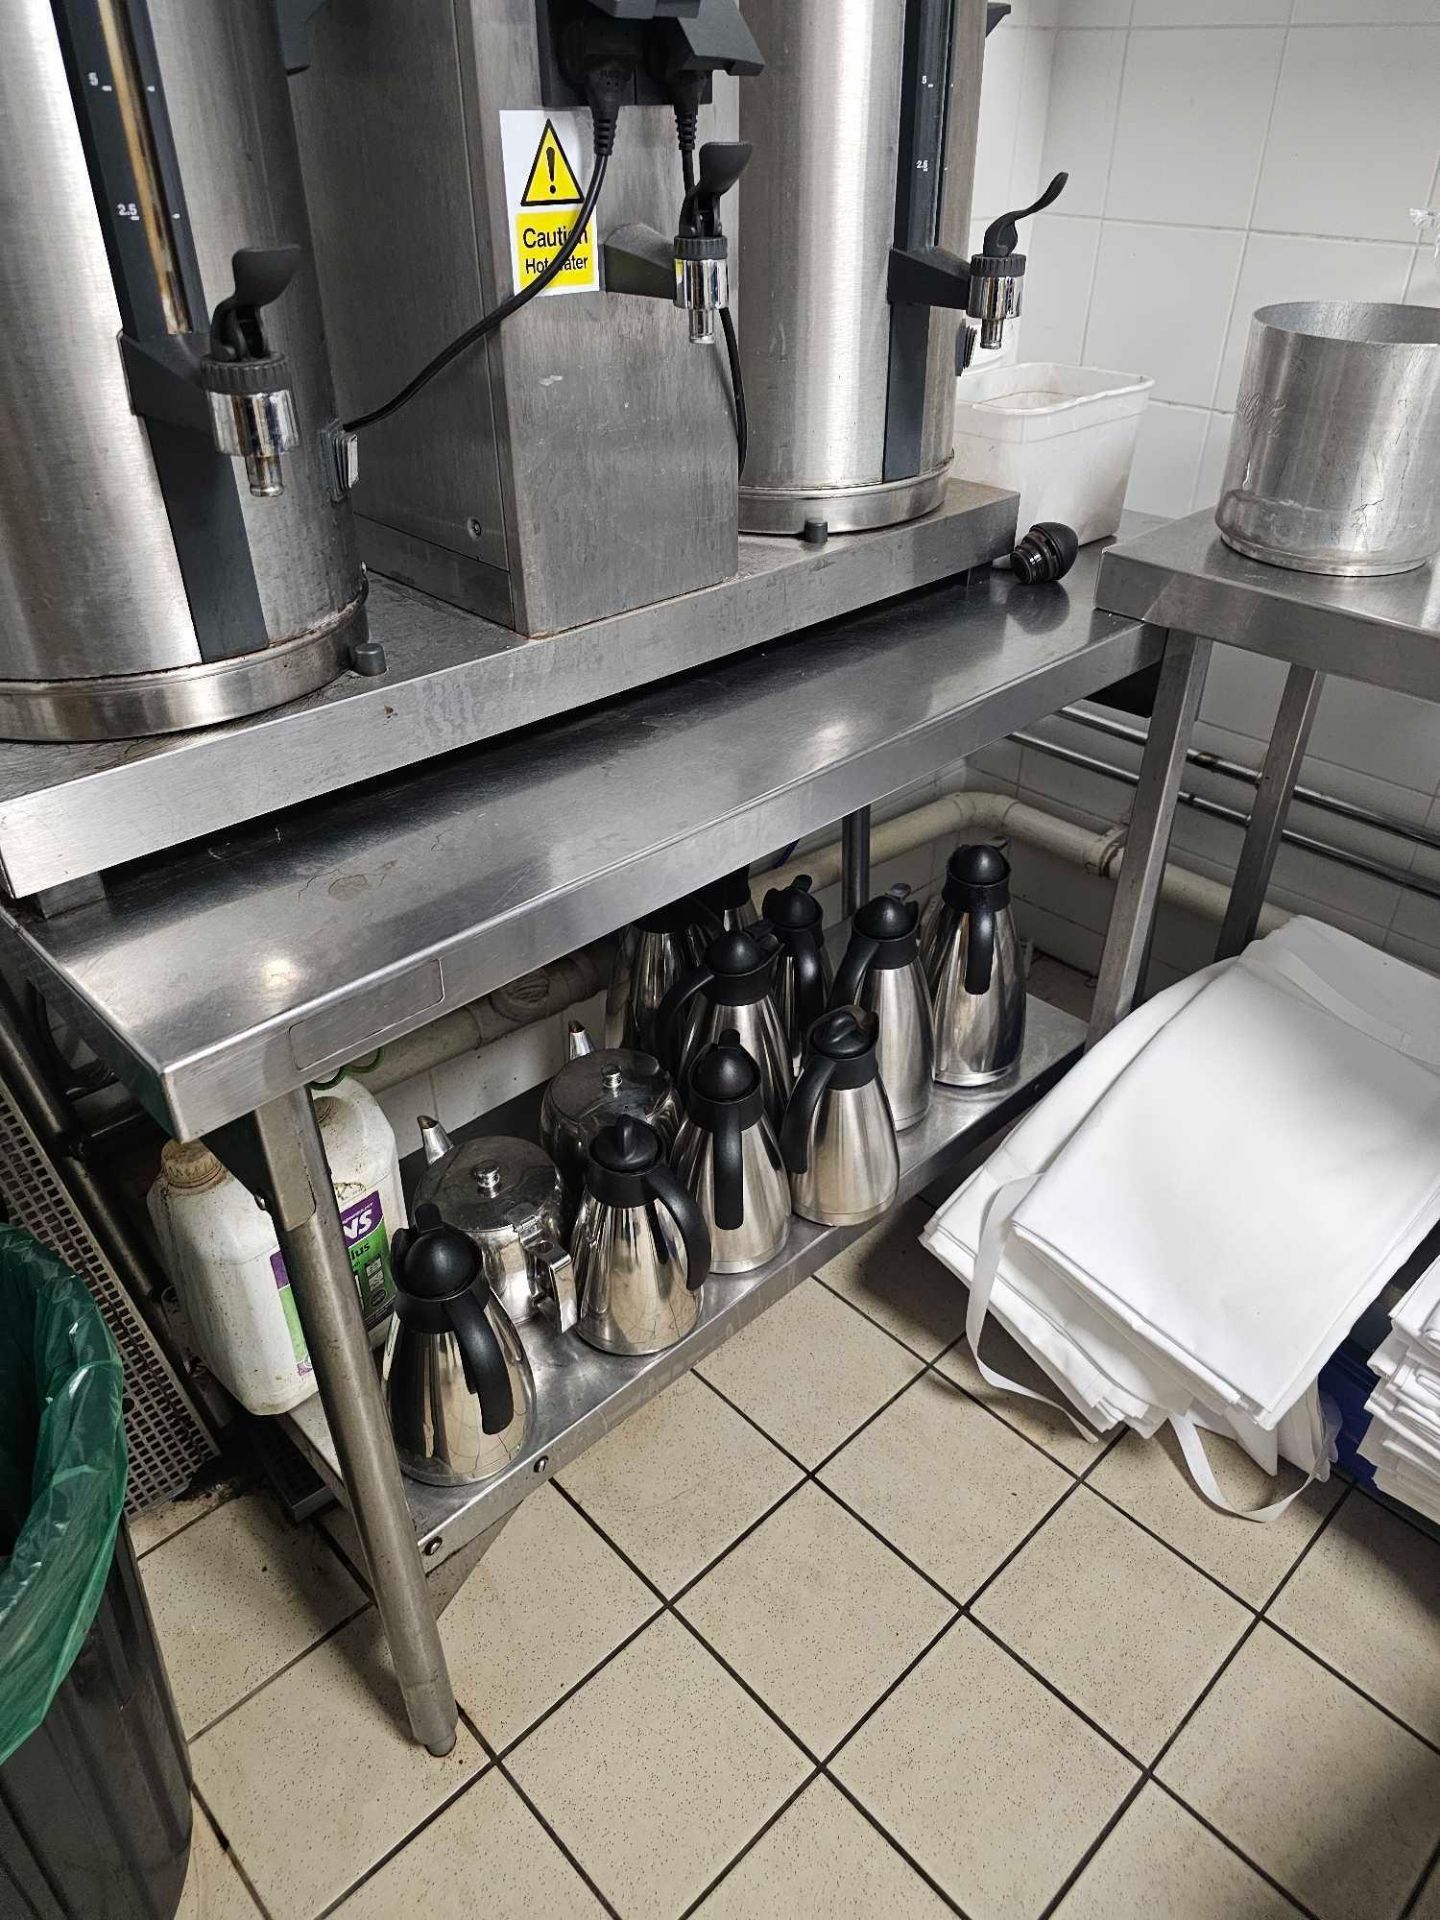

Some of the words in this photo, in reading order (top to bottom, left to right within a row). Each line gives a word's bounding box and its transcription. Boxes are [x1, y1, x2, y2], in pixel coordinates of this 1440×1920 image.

[88, 72, 99, 86] 5
[117, 203, 138, 216] 2.5
[522, 226, 588, 249] Cautin
[556, 255, 589, 272] ater
